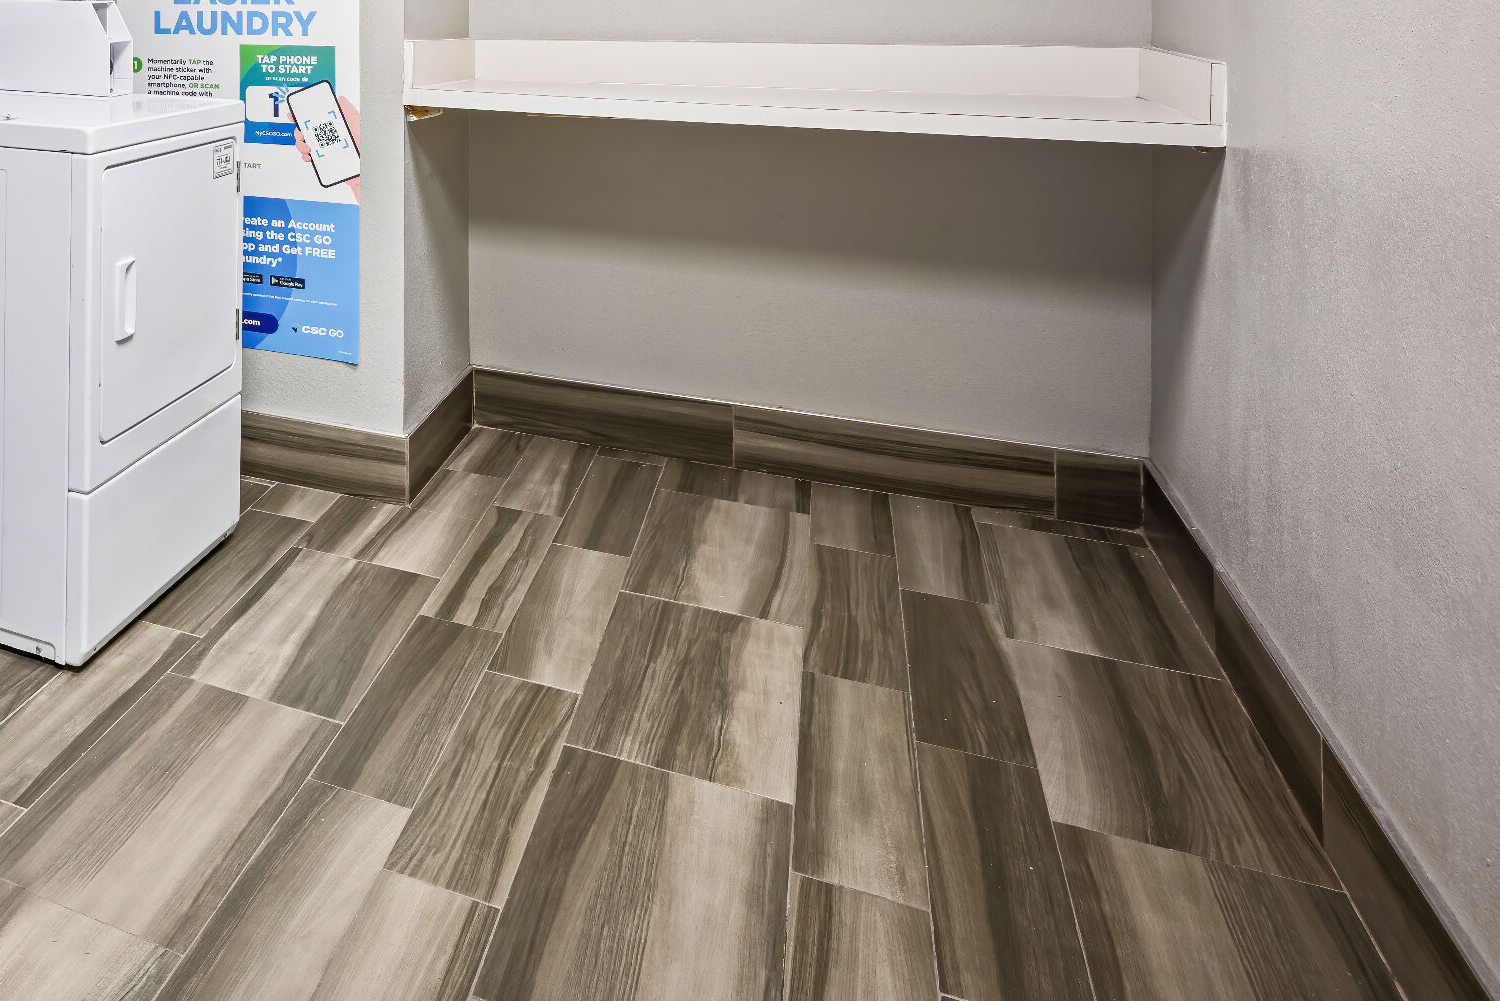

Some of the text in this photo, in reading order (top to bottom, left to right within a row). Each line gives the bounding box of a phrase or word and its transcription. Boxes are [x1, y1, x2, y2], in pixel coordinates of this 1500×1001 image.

[154, 10, 318, 37] LAUNDRY
[147, 58, 187, 66] Momentarily
[256, 55, 318, 65] TAP PHONE
[260, 64, 314, 74] TO START
[163, 74, 205, 82] NFC-capable
[147, 82, 187, 90] smartphone,
[268, 91, 280, 118] 1
[243, 216, 336, 233] eate an Account
[243, 228, 332, 245] sing the CSC GO
[243, 242, 336, 259] pp and Get FREE
[301, 325, 344, 338] CSC GO
